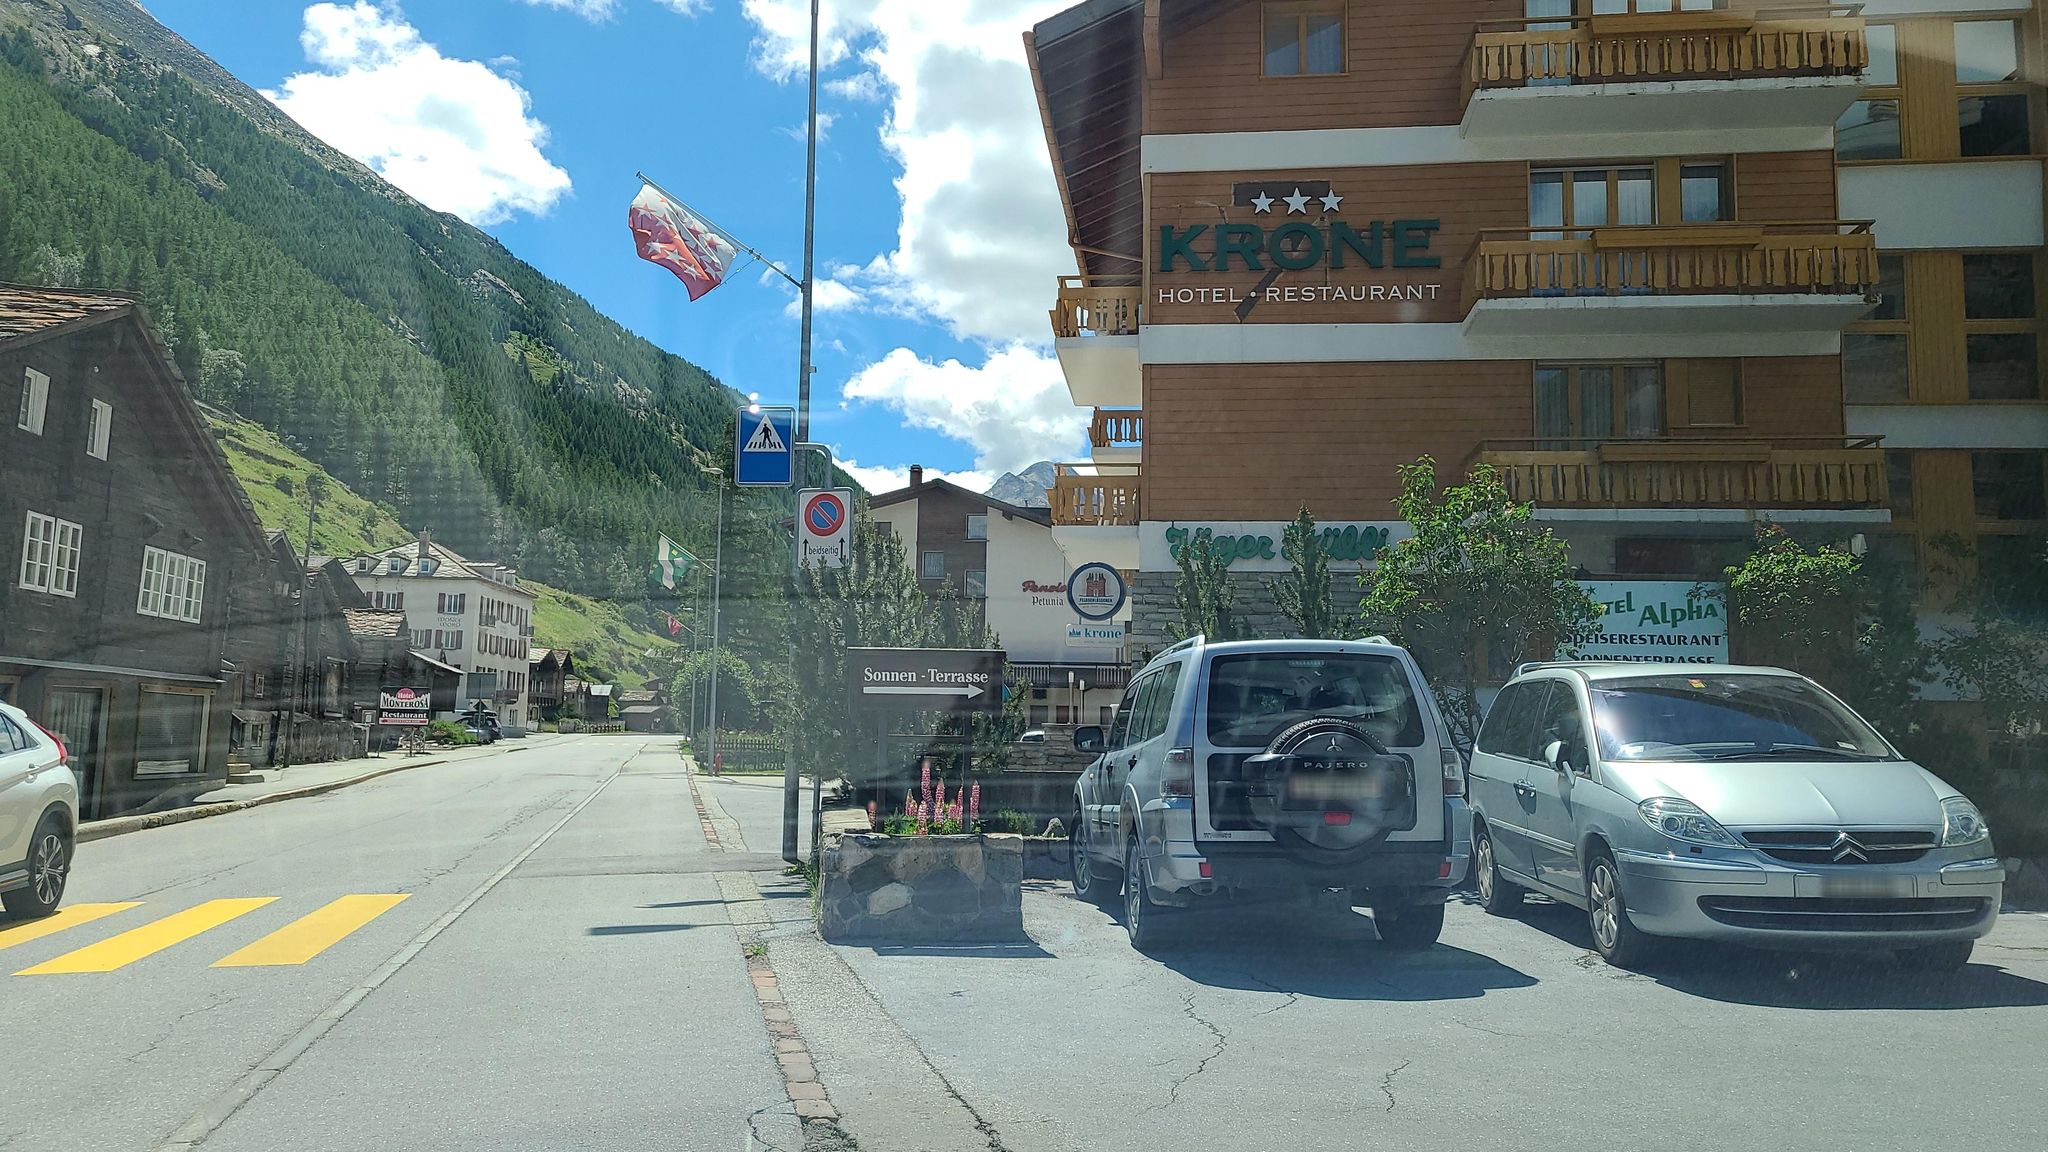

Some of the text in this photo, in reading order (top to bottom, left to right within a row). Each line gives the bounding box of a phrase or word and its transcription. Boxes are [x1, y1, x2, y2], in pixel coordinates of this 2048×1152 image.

[1159, 219, 1441, 272] KRONE
[1158, 284, 1441, 303] HOTEL RESTAURANT
[808, 545, 839, 556] beidseitig
[1032, 596, 1064, 606] Petunia
[1084, 628, 1122, 639] krone
[864, 667, 917, 682] Sonnen
[928, 668, 989, 683] Terrasse
[381, 694, 428, 708] MONTEROSA
[382, 711, 427, 719] Restaurant
